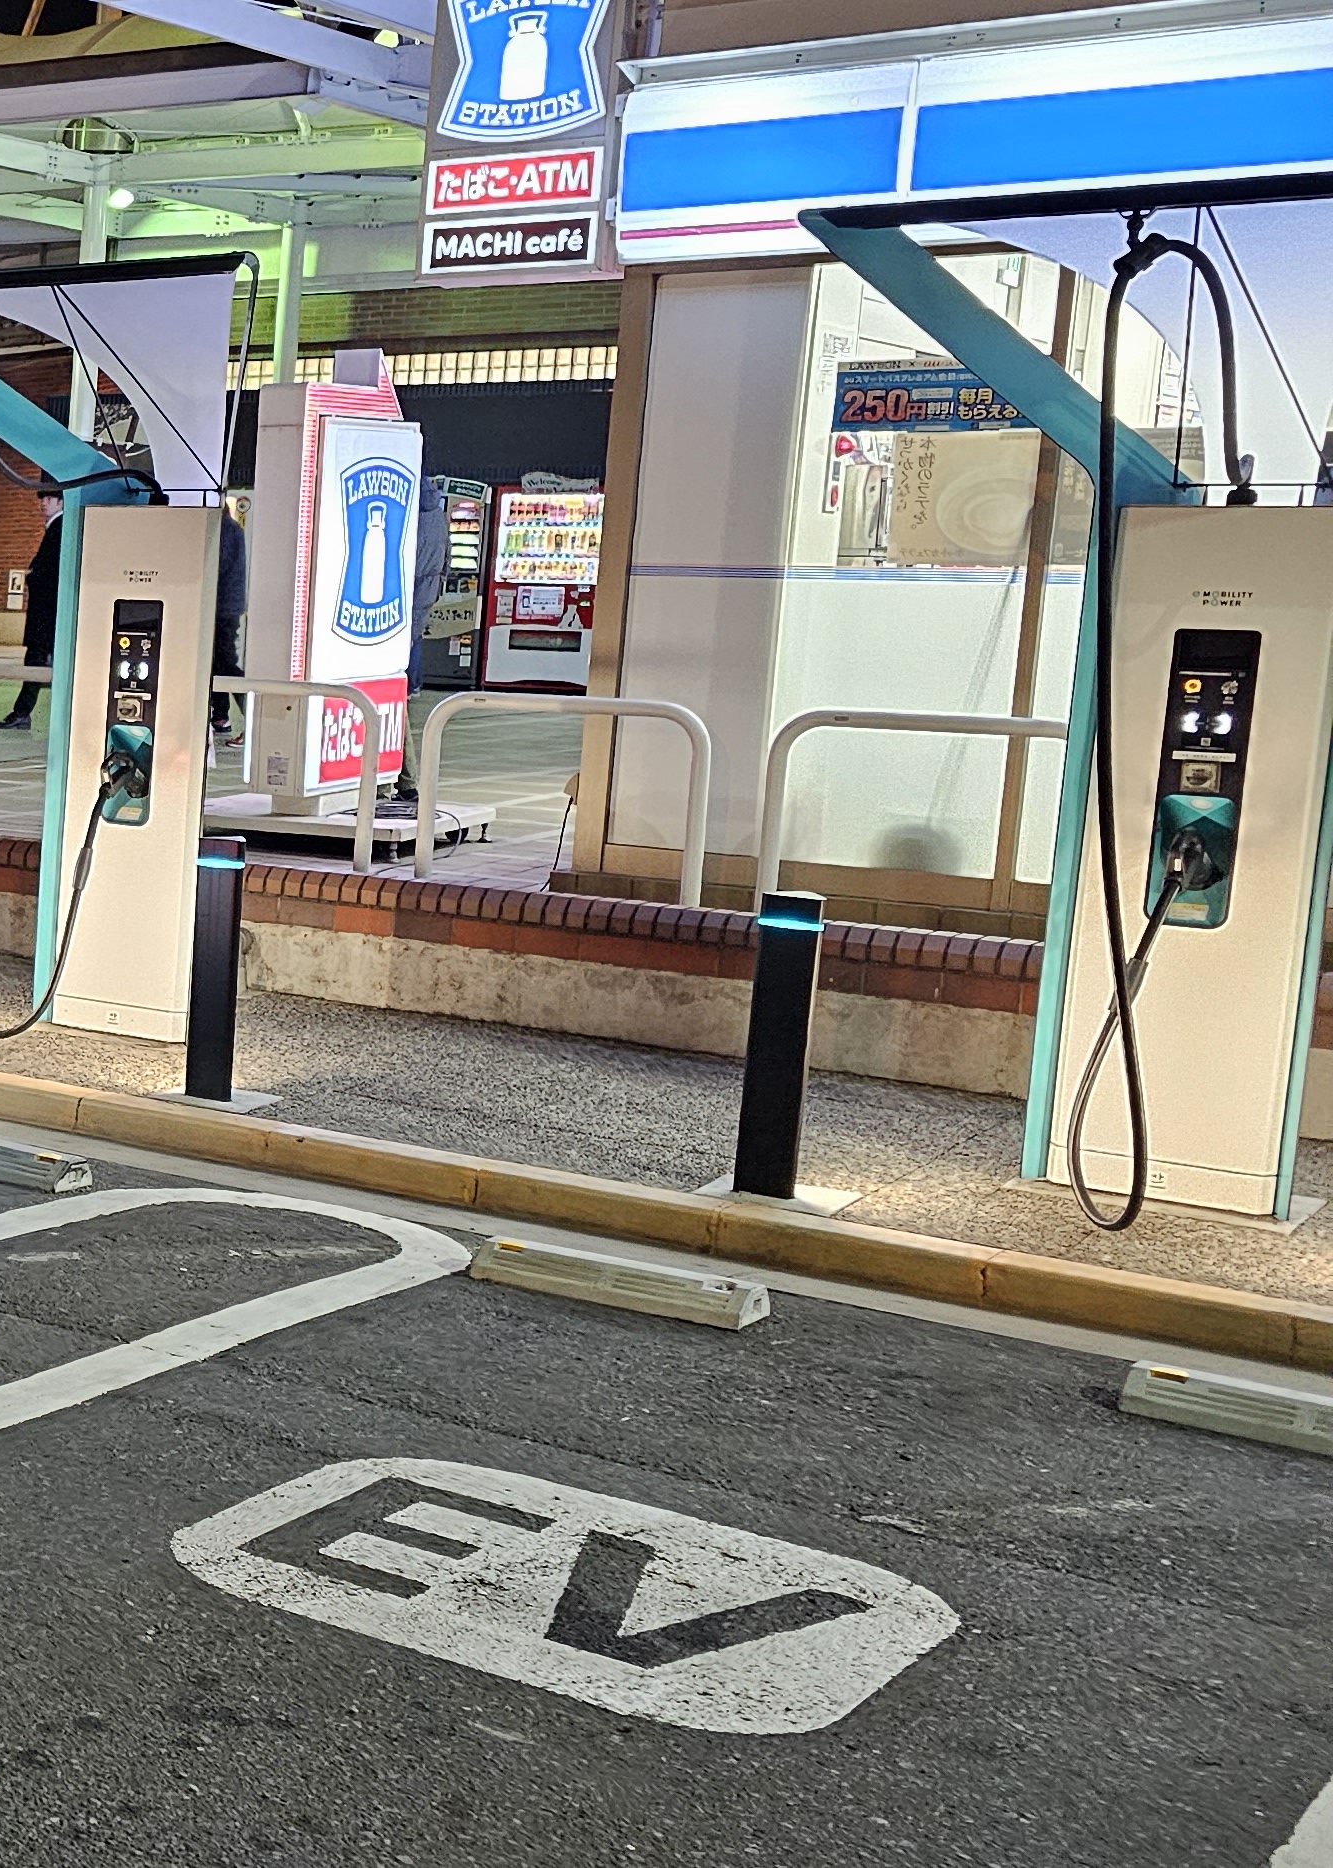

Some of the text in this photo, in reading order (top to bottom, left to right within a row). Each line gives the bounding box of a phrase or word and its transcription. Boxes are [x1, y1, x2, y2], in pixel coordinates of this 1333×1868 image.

[458, 88, 583, 127] STATION
[437, 159, 589, 202] たばこ・ATM
[435, 228, 584, 260] MACHI café
[848, 360, 901, 370] LAWSON
[841, 388, 927, 423] 250円
[958, 388, 993, 404] 毎月
[347, 470, 409, 507] LAWSON
[1202, 590, 1253, 600] MOBILITY
[1202, 598, 1242, 607] POWER
[339, 598, 400, 633] STATION
[321, 701, 404, 763] たばこTM
[238, 1476, 875, 1669] EV
